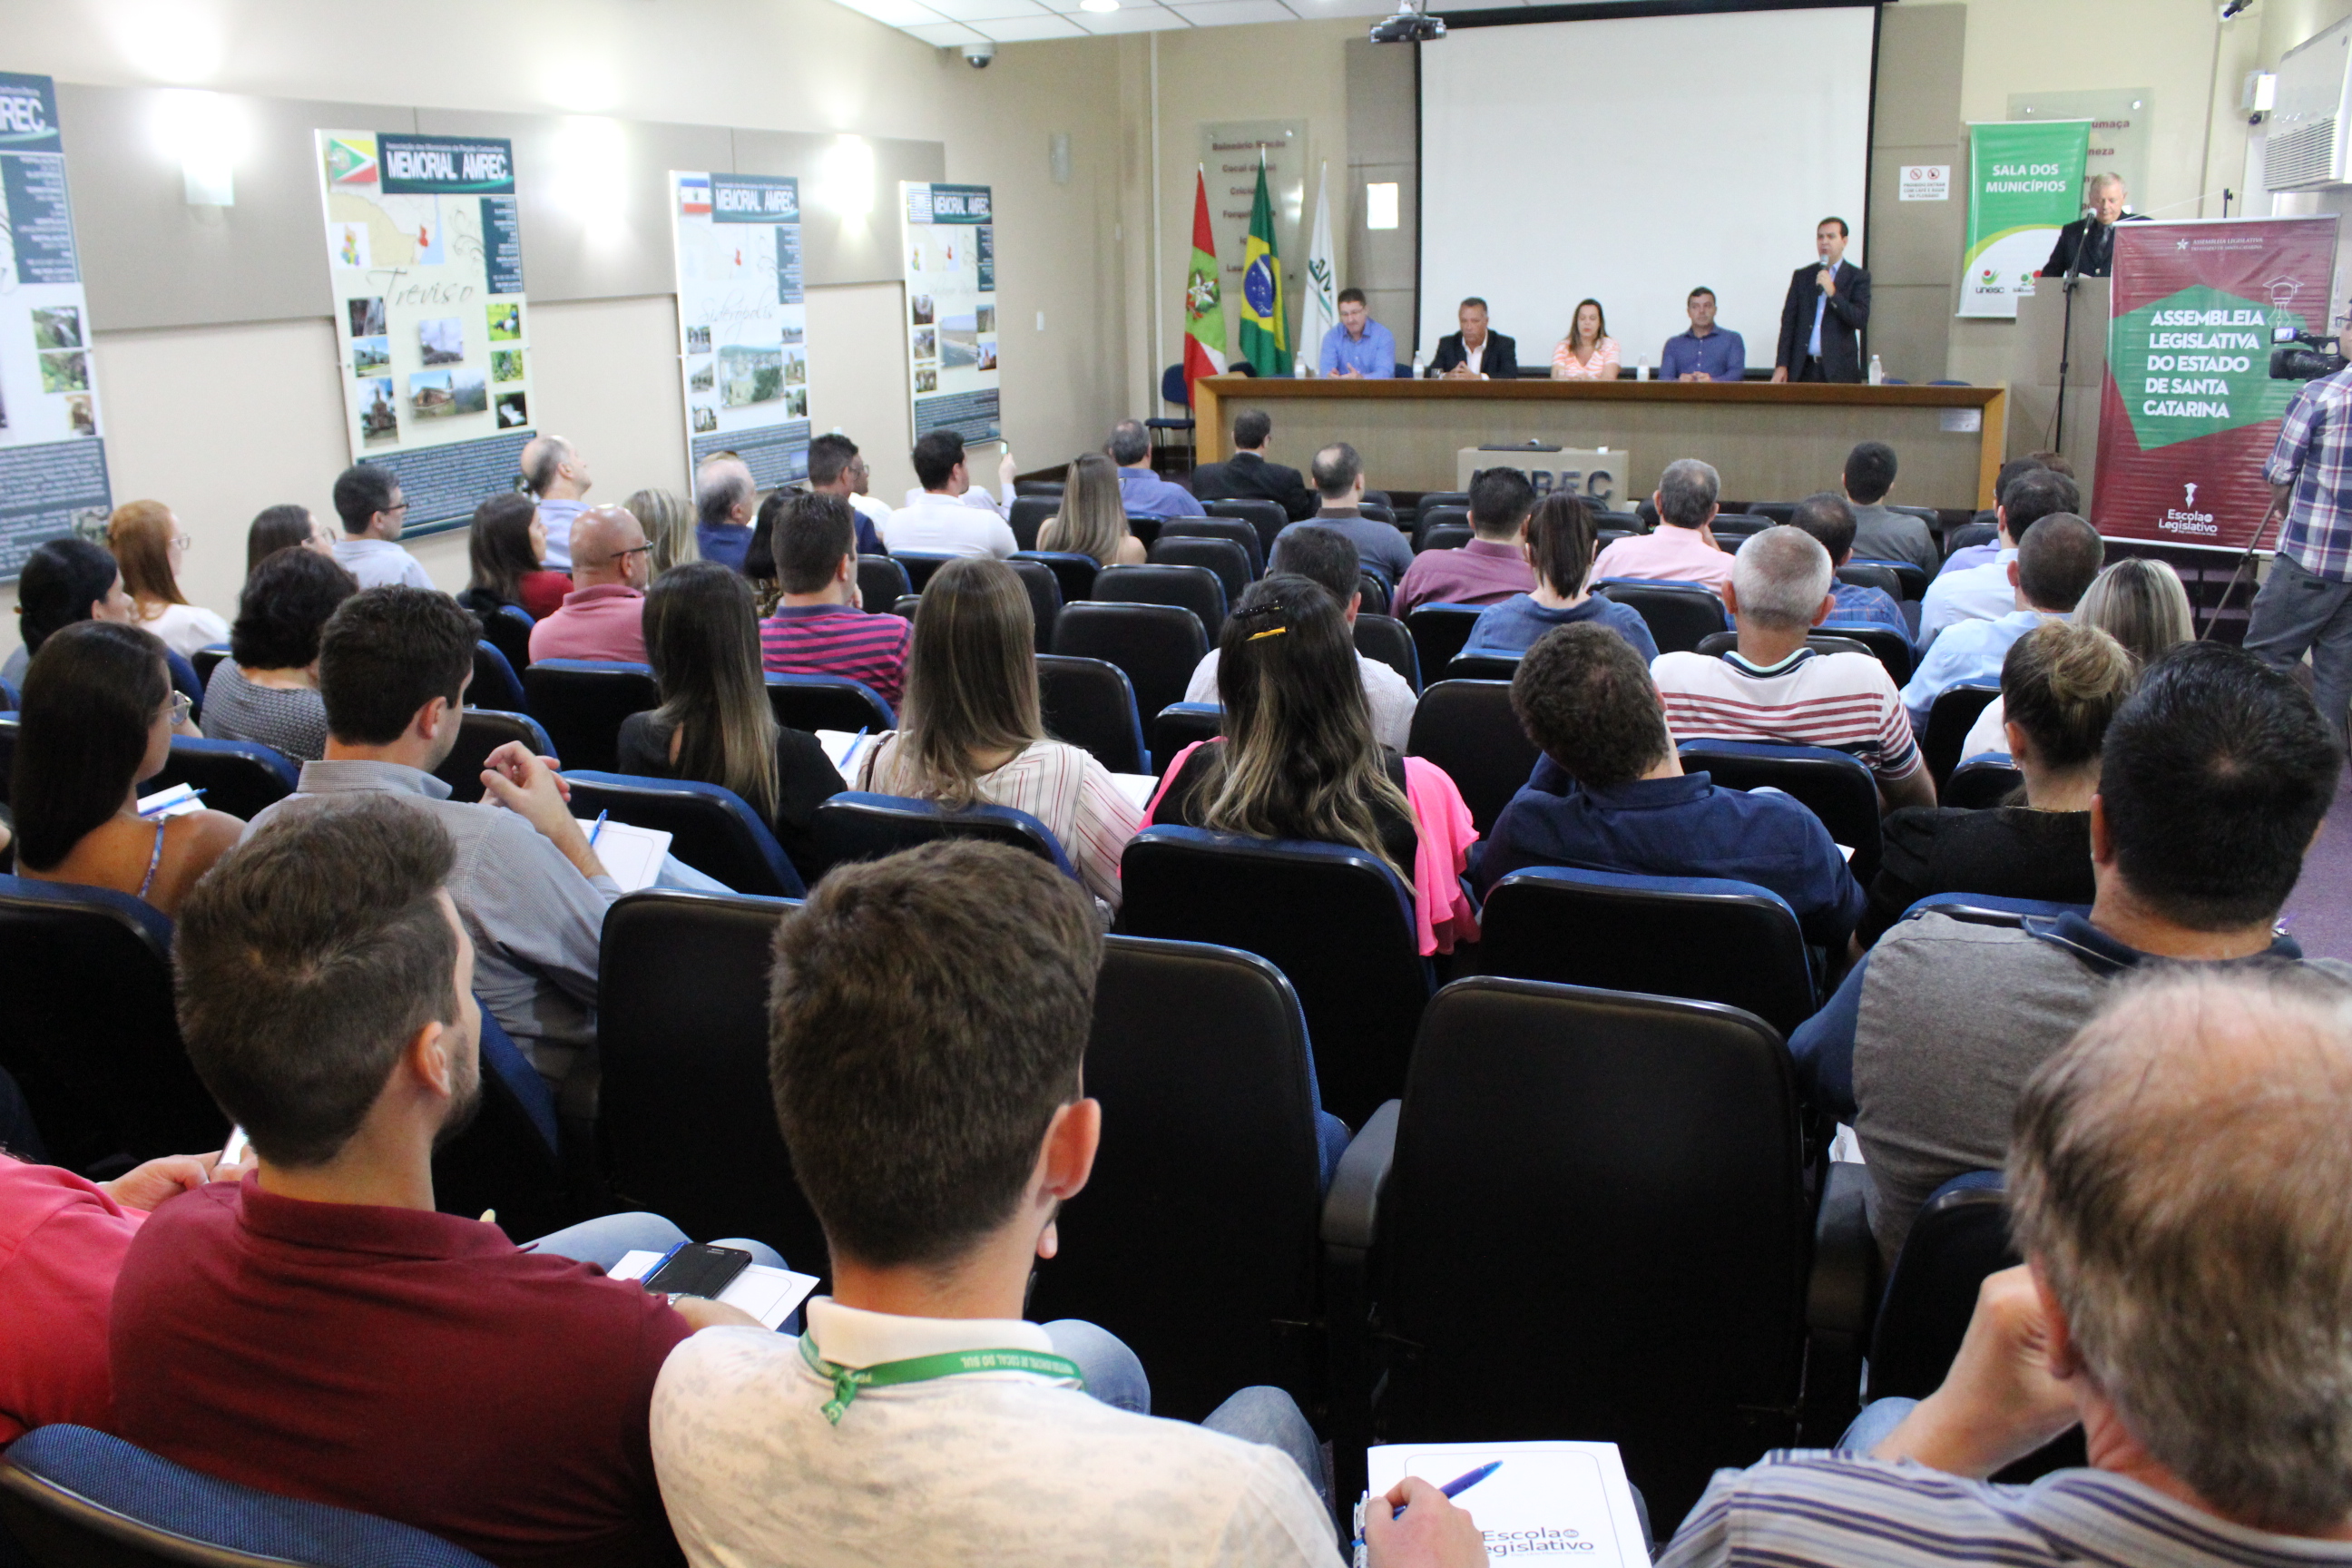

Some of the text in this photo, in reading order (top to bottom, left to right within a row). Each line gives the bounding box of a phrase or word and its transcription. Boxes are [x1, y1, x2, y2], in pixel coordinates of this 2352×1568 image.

[0, 95, 45, 132] REC
[2092, 120, 2130, 130] umaça
[2088, 148, 2114, 156] neza
[387, 151, 507, 181] MEMORIAL AMREC
[1993, 163, 2059, 176] SALA DOS
[1985, 179, 2066, 192] MUNICÍPIOS
[715, 189, 794, 211] MEMORIAL AMREC
[366, 267, 474, 313] Treviso
[1975, 286, 2004, 294] unesc
[2151, 310, 2265, 326] ASSEMBLEIA
[2149, 333, 2259, 349] LEGISLATIVA
[2147, 355, 2250, 372] DO ESTADO
[2145, 377, 2230, 395] DE SANTA
[2142, 400, 2230, 418] CATARINA
[2168, 509, 2204, 522] Escola
[2159, 518, 2218, 533] Legislativo
[1482, 1527, 1561, 1542] Escola
[1486, 1539, 1594, 1557] egislativo
